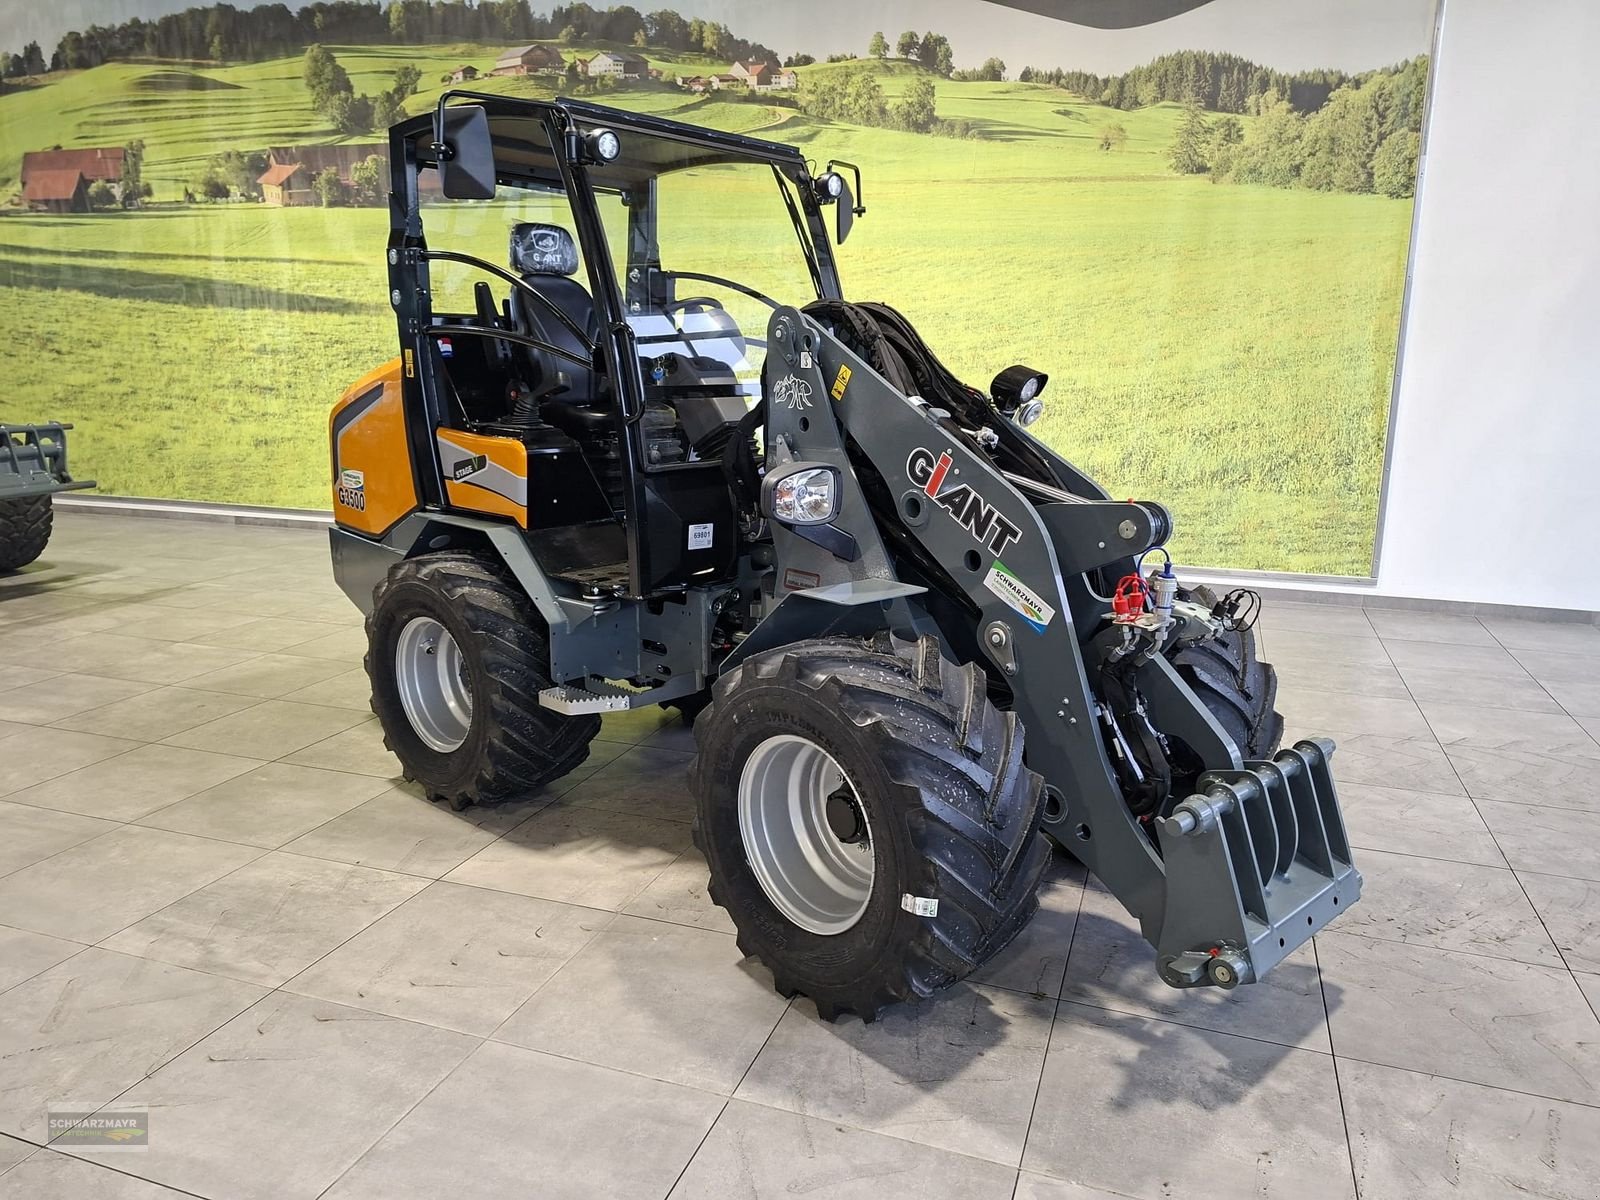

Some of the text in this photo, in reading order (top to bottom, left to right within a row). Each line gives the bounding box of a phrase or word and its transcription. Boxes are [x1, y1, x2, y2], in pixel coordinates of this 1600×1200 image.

[533, 253, 562, 263] GANT
[455, 465, 473, 479] STAGE
[338, 485, 365, 512] G3500
[995, 570, 1043, 614] SCHWARZMAYR
